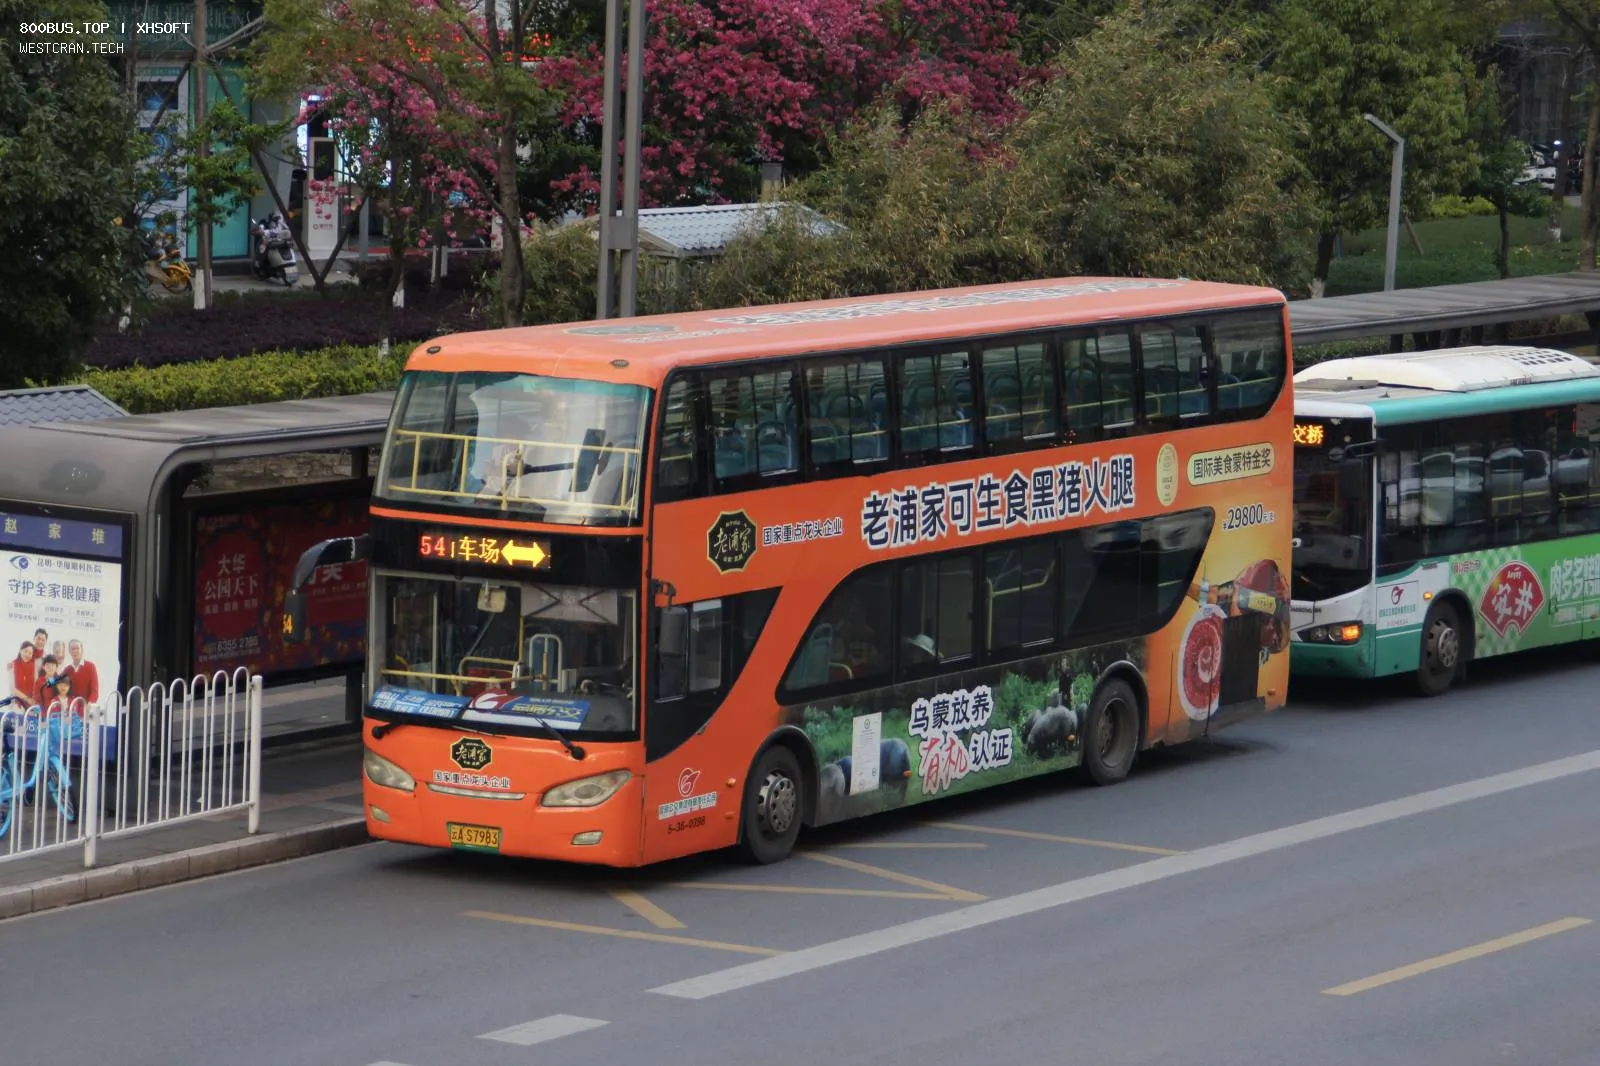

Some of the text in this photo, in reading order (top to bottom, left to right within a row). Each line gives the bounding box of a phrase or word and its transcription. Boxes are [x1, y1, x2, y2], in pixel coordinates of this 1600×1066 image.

[1193, 447, 1271, 479] 国际美食蒙特金奖
[863, 455, 1134, 548] 老浦家可生食黑猪火腿
[3, 517, 105, 544] 赵家堆
[763, 517, 842, 545] 国家重点龙头企业
[420, 535, 446, 556] 54
[458, 536, 500, 564] 车场
[217, 553, 246, 576] 大华
[8, 578, 101, 603] 守护全家眼健康
[204, 573, 259, 601] 公园天下
[1492, 580, 1533, 625] 安井
[911, 691, 990, 733] 乌蒙放养
[922, 732, 1010, 790] 有机认证
